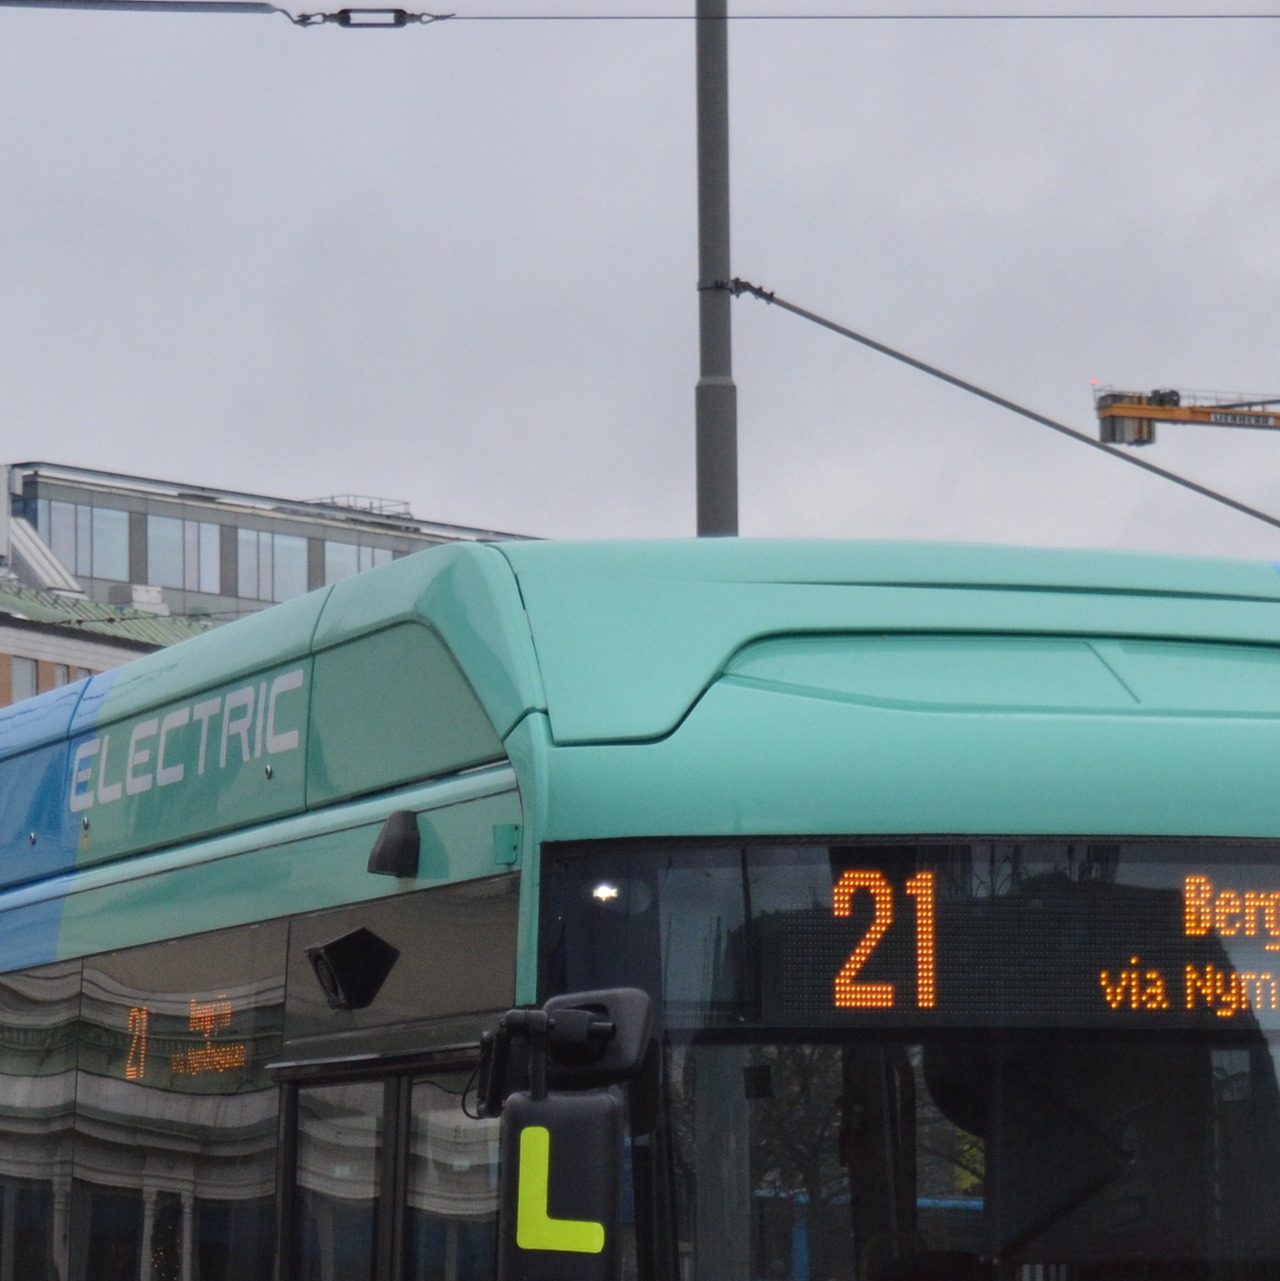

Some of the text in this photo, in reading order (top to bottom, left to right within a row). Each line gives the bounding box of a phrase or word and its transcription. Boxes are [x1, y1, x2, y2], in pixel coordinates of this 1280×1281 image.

[70, 669, 304, 813] ELECTRIC
[833, 871, 936, 1008] 21
[1100, 955, 1169, 1009] via
